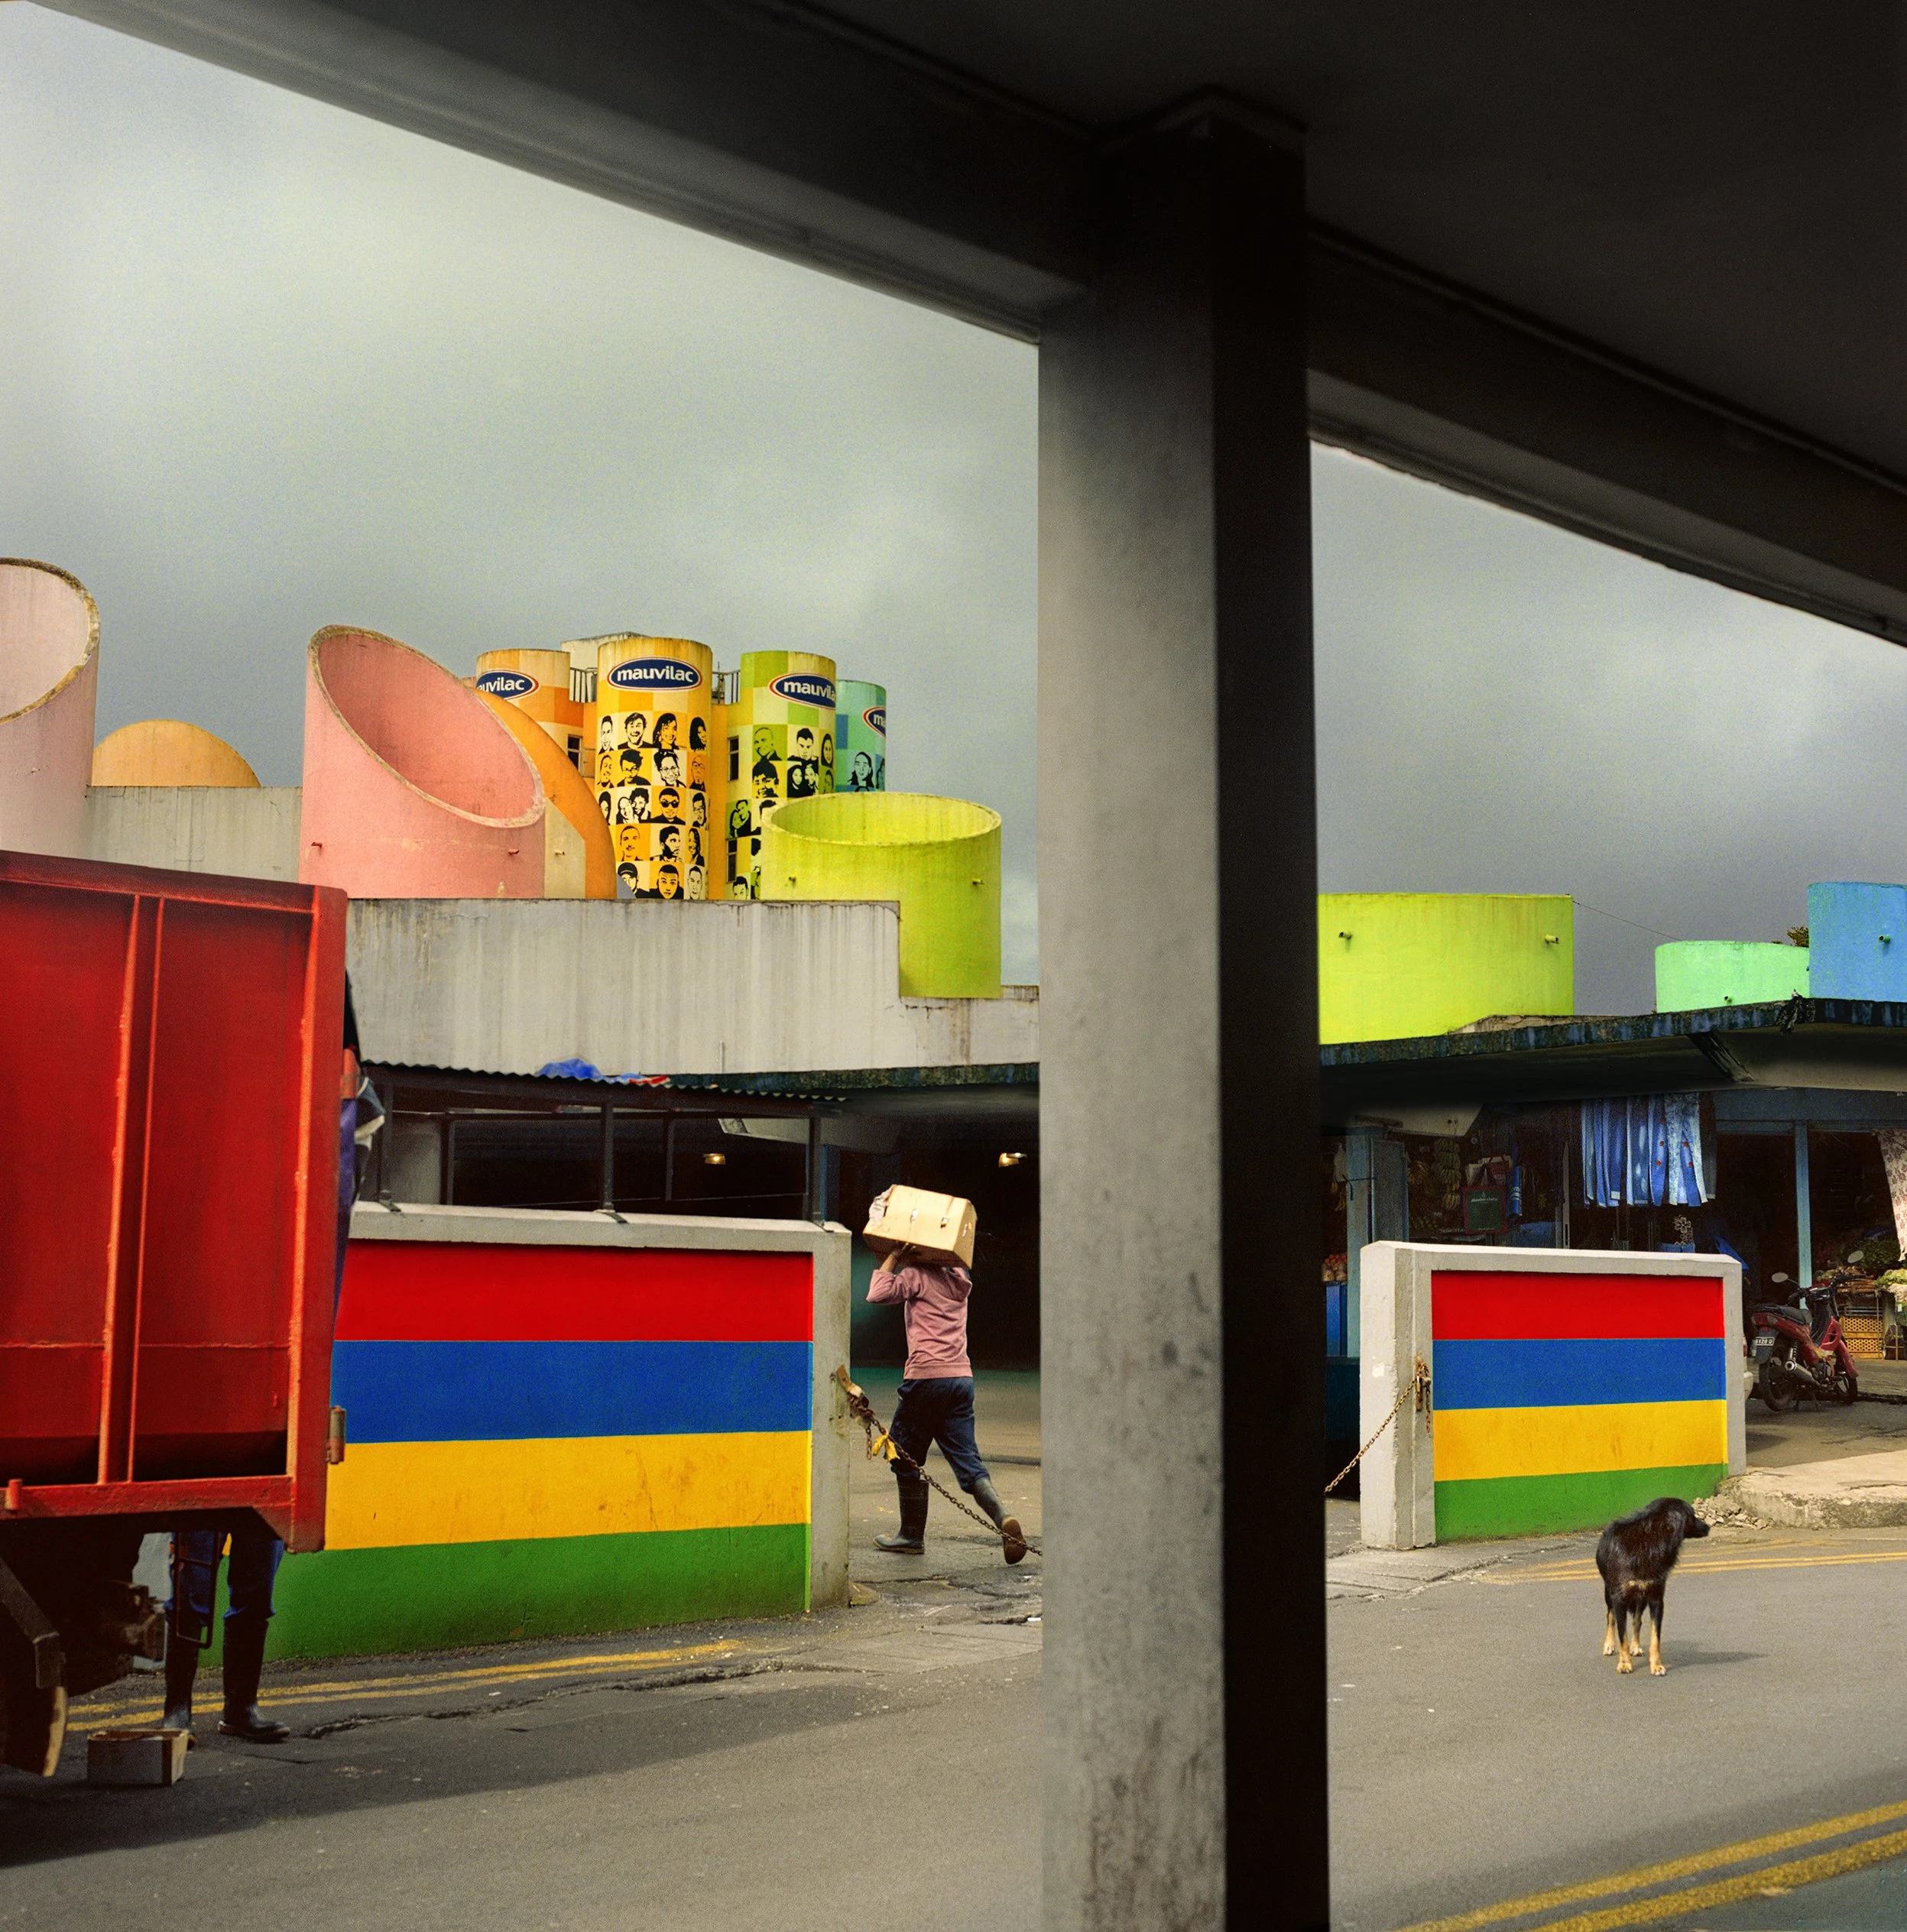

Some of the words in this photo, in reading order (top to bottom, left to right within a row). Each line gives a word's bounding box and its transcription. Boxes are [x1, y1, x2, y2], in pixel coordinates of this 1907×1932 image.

[617, 666, 694, 682] mauvilac
[477, 677, 525, 692] auvilac
[783, 681, 835, 702] mauvila
